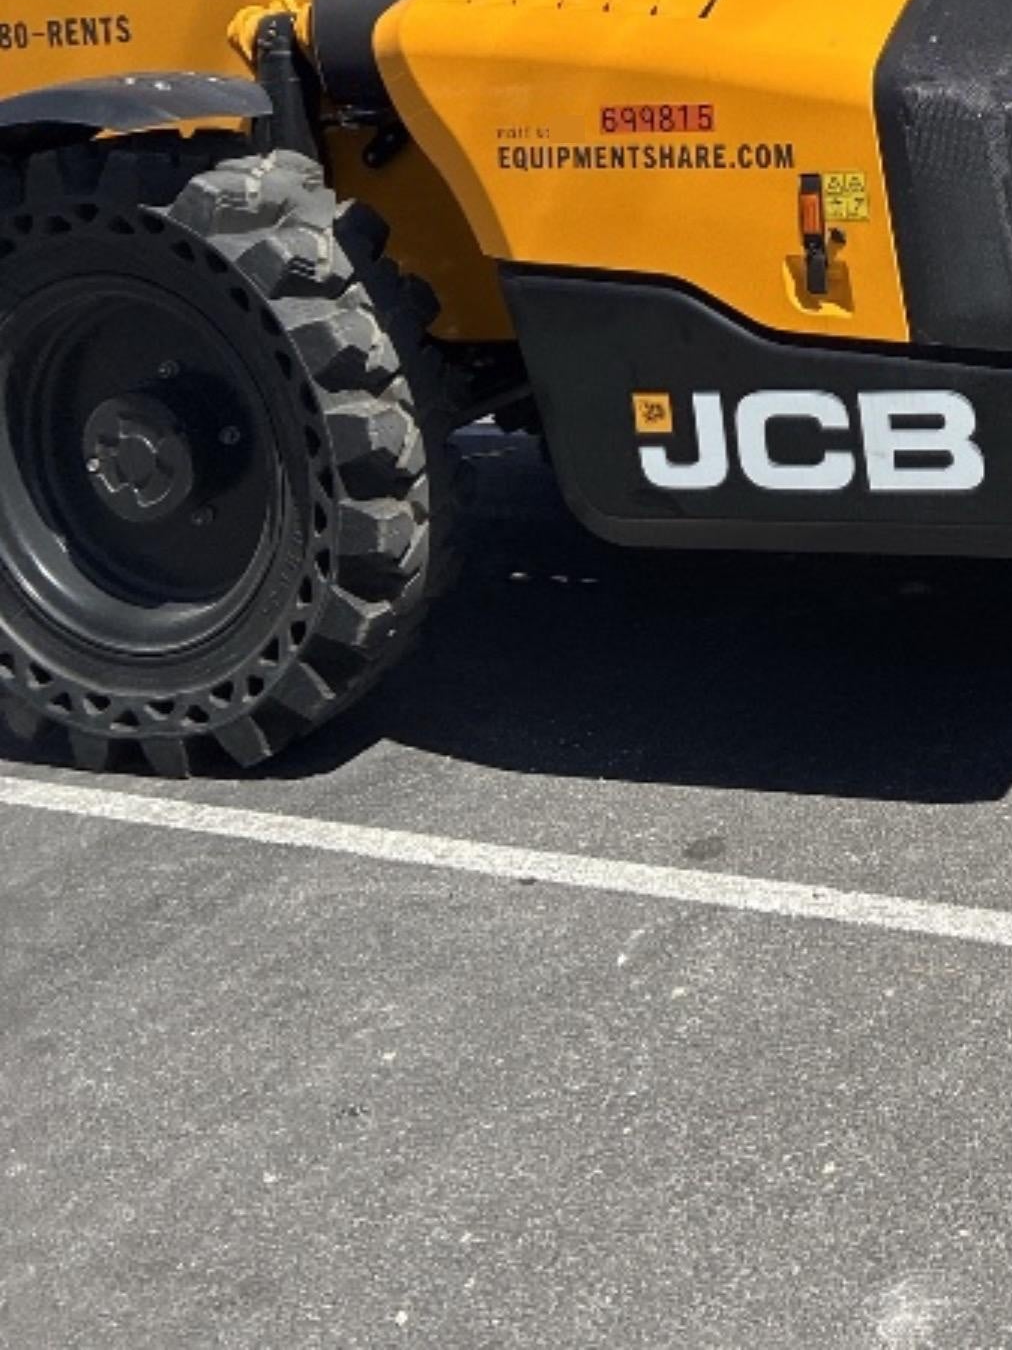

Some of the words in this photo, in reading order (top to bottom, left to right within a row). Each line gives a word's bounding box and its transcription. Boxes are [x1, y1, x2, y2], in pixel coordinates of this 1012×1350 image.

[601, 105, 713, 132] 699815
[497, 143, 796, 170] EQUIPMENTSHARE.COM
[638, 390, 986, 490] JCB
